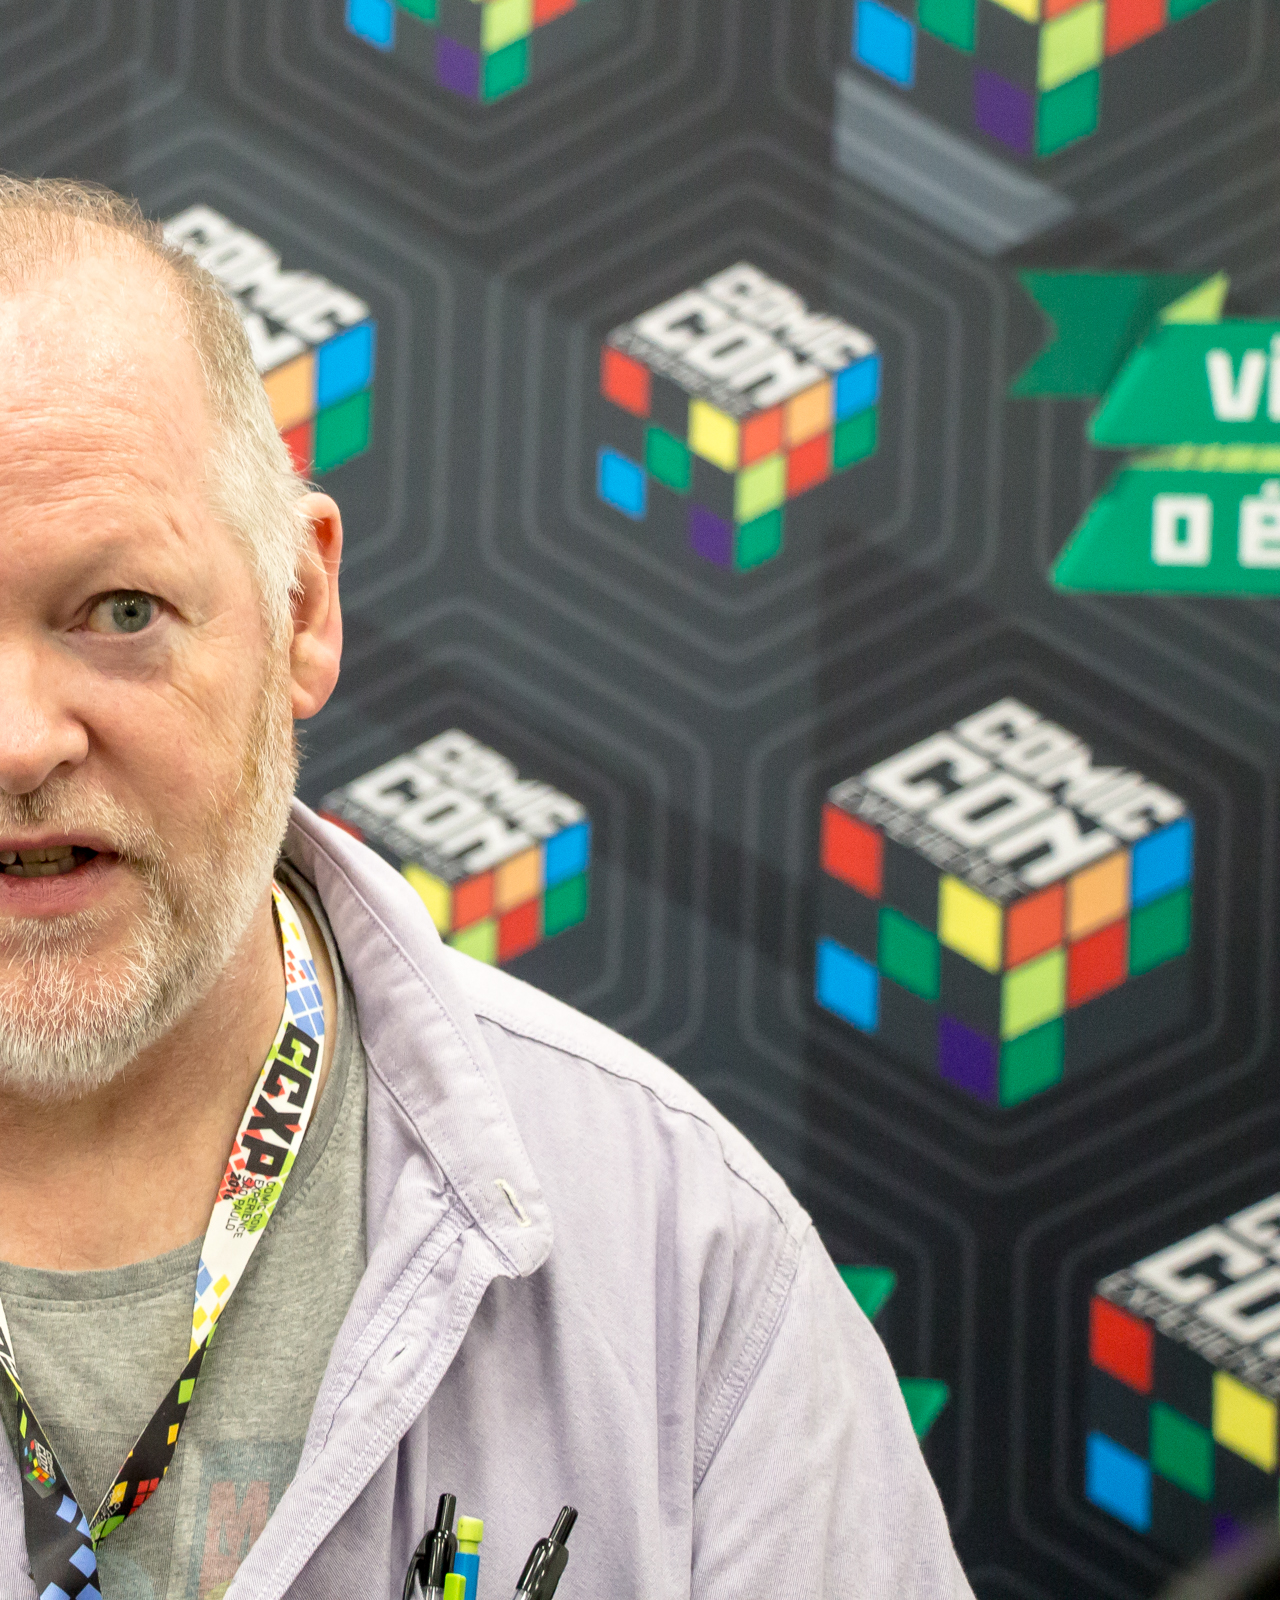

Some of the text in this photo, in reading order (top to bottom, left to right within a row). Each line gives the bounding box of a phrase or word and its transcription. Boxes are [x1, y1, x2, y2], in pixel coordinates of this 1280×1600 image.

[162, 203, 370, 346] COMIC
[703, 260, 876, 372] COMIC
[634, 289, 822, 409] CON
[1150, 491, 1214, 568] o
[346, 753, 536, 874] CON
[417, 727, 587, 839] COMIC
[860, 729, 1120, 890] CON
[952, 696, 1190, 842] COMIC
[241, 1021, 319, 1177] CCXP
[223, 1171, 242, 1200] 2016
[225, 1199, 246, 1231] PAULO
[233, 1178, 265, 1239] EXPERIENCE
[247, 1180, 276, 1232] COMIC CON
[1130, 1222, 1280, 1360] CO
